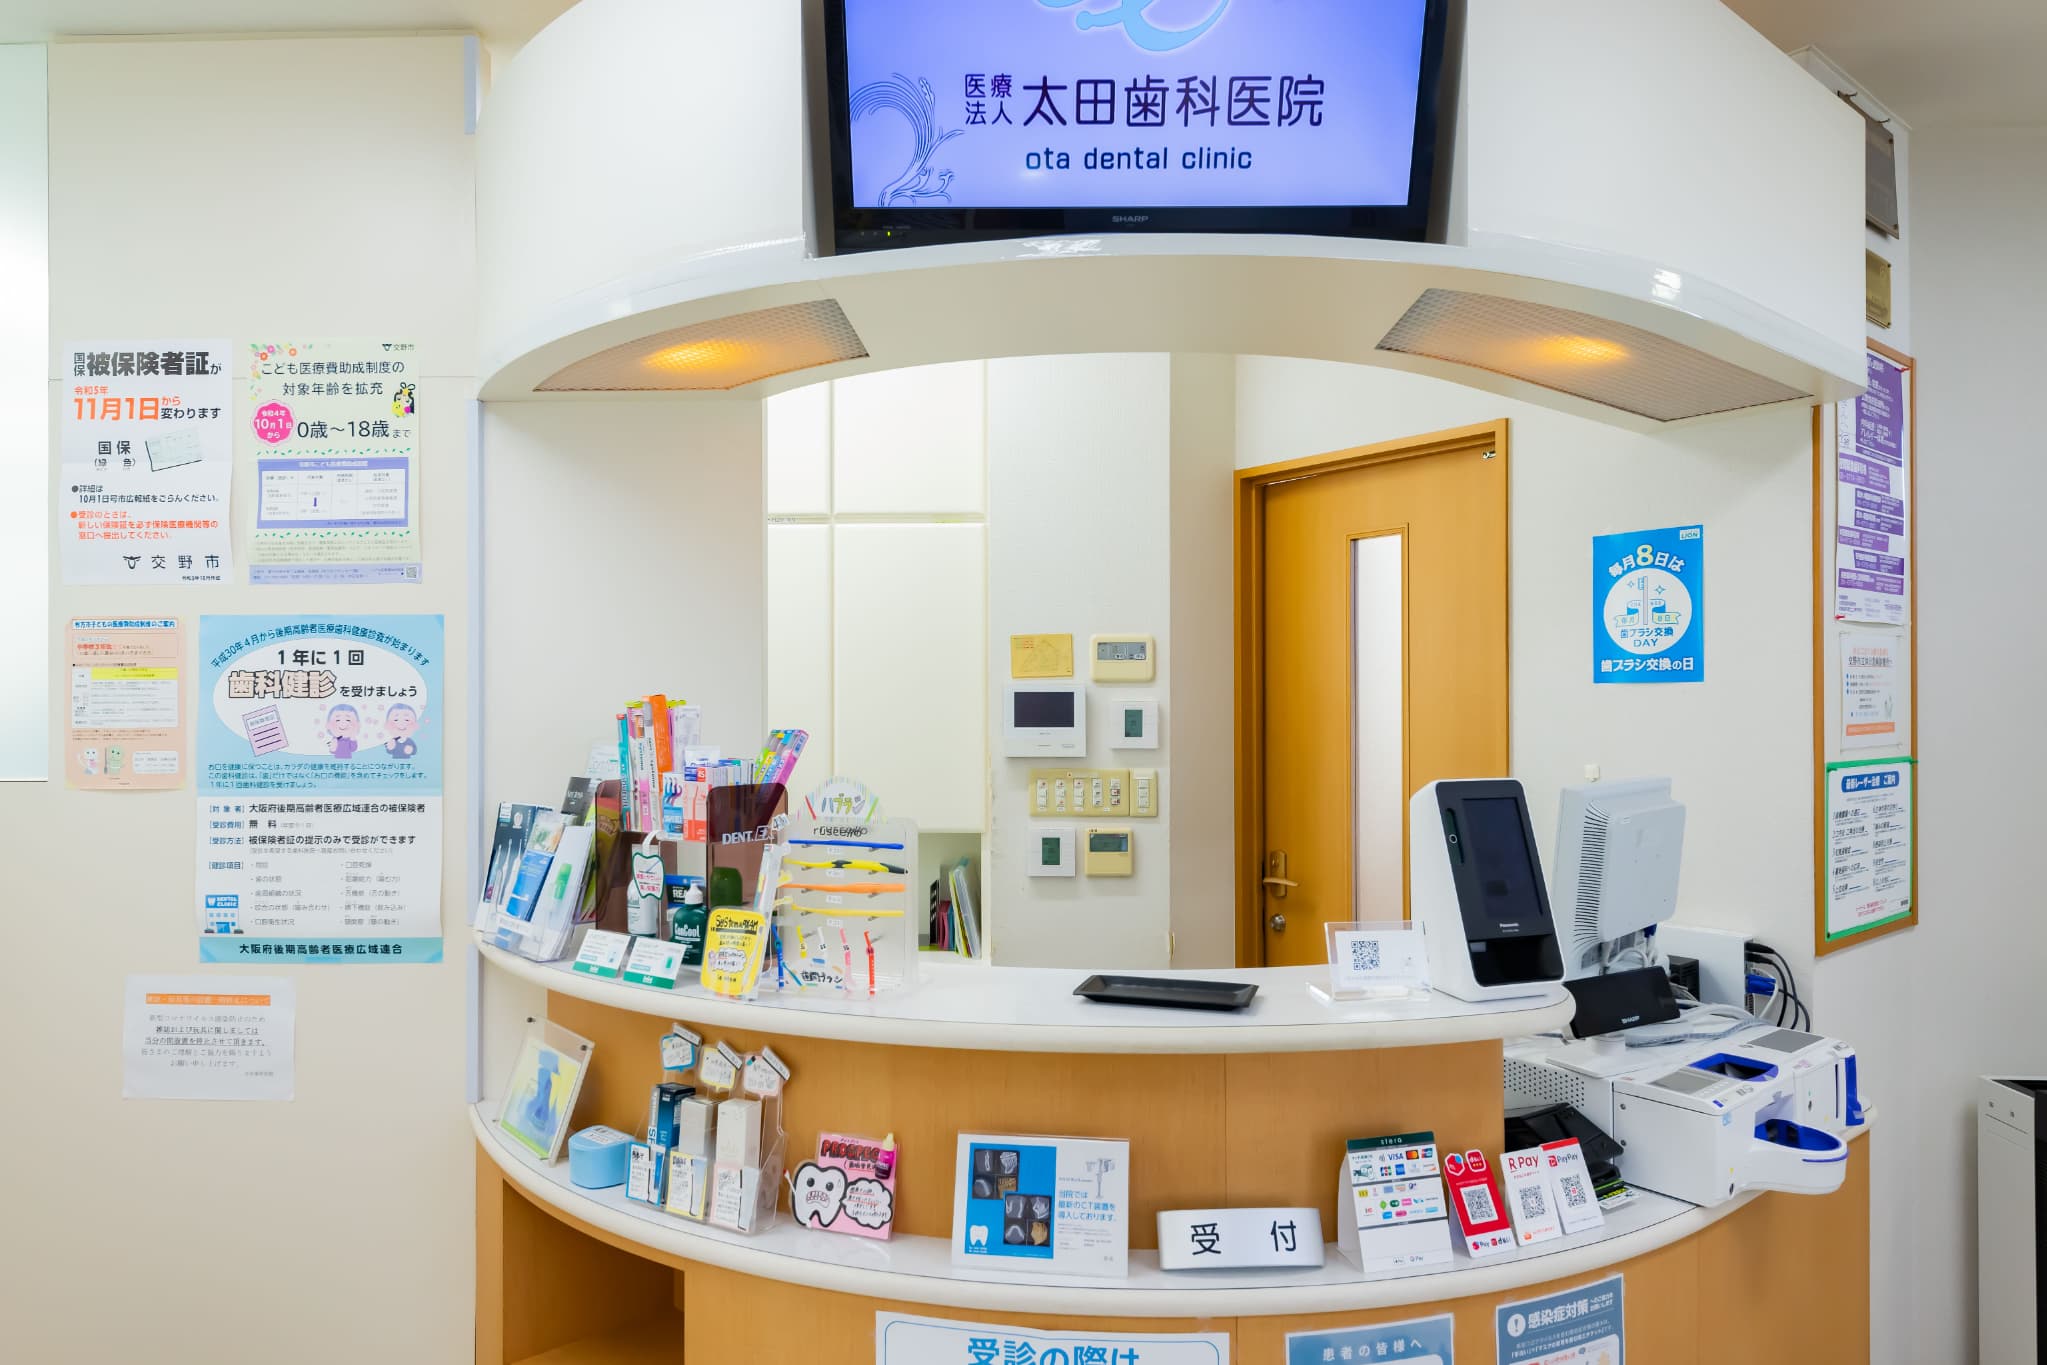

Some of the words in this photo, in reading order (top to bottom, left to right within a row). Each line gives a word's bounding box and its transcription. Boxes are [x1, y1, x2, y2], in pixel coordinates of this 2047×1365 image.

[964, 73, 1012, 98] 医療
[1022, 74, 1325, 128] 太田歯科医院
[964, 100, 1012, 126] 法人
[1025, 147, 1071, 170] ota
[1083, 146, 1168, 170] dental
[1181, 146, 1253, 170] clinic
[1111, 215, 1149, 223] SHARP
[261, 361, 405, 375] こども医療費助成制度の
[74, 386, 109, 395] 令和5年
[282, 382, 383, 396] 対象年齢を拡充
[73, 397, 159, 421] 11月1日
[161, 396, 181, 406] から
[160, 407, 222, 420] 変わります
[97, 440, 131, 455] 国保
[151, 554, 220, 570] 交野市
[1608, 544, 1685, 577] 毎月8日は
[1620, 626, 1674, 638] 歯ブラシ交換
[1633, 638, 1659, 647] DAY
[278, 649, 365, 666] 1年に1回
[1601, 657, 1694, 673] 歯ブラシ交換の日
[228, 669, 337, 699] 歯科健診
[339, 685, 418, 697] を受けましょう
[239, 943, 403, 955] 大阪府後期高齢者医療広域連合
[1387, 1153, 1404, 1161] VISA
[1519, 1155, 1539, 1168] Pay
[1190, 1220, 1297, 1256] 受付
[1528, 1299, 1589, 1329] 感染症対策
[967, 1338, 1139, 1365] 受診の際は
[1323, 1338, 1422, 1361] 患者の皆様へ
